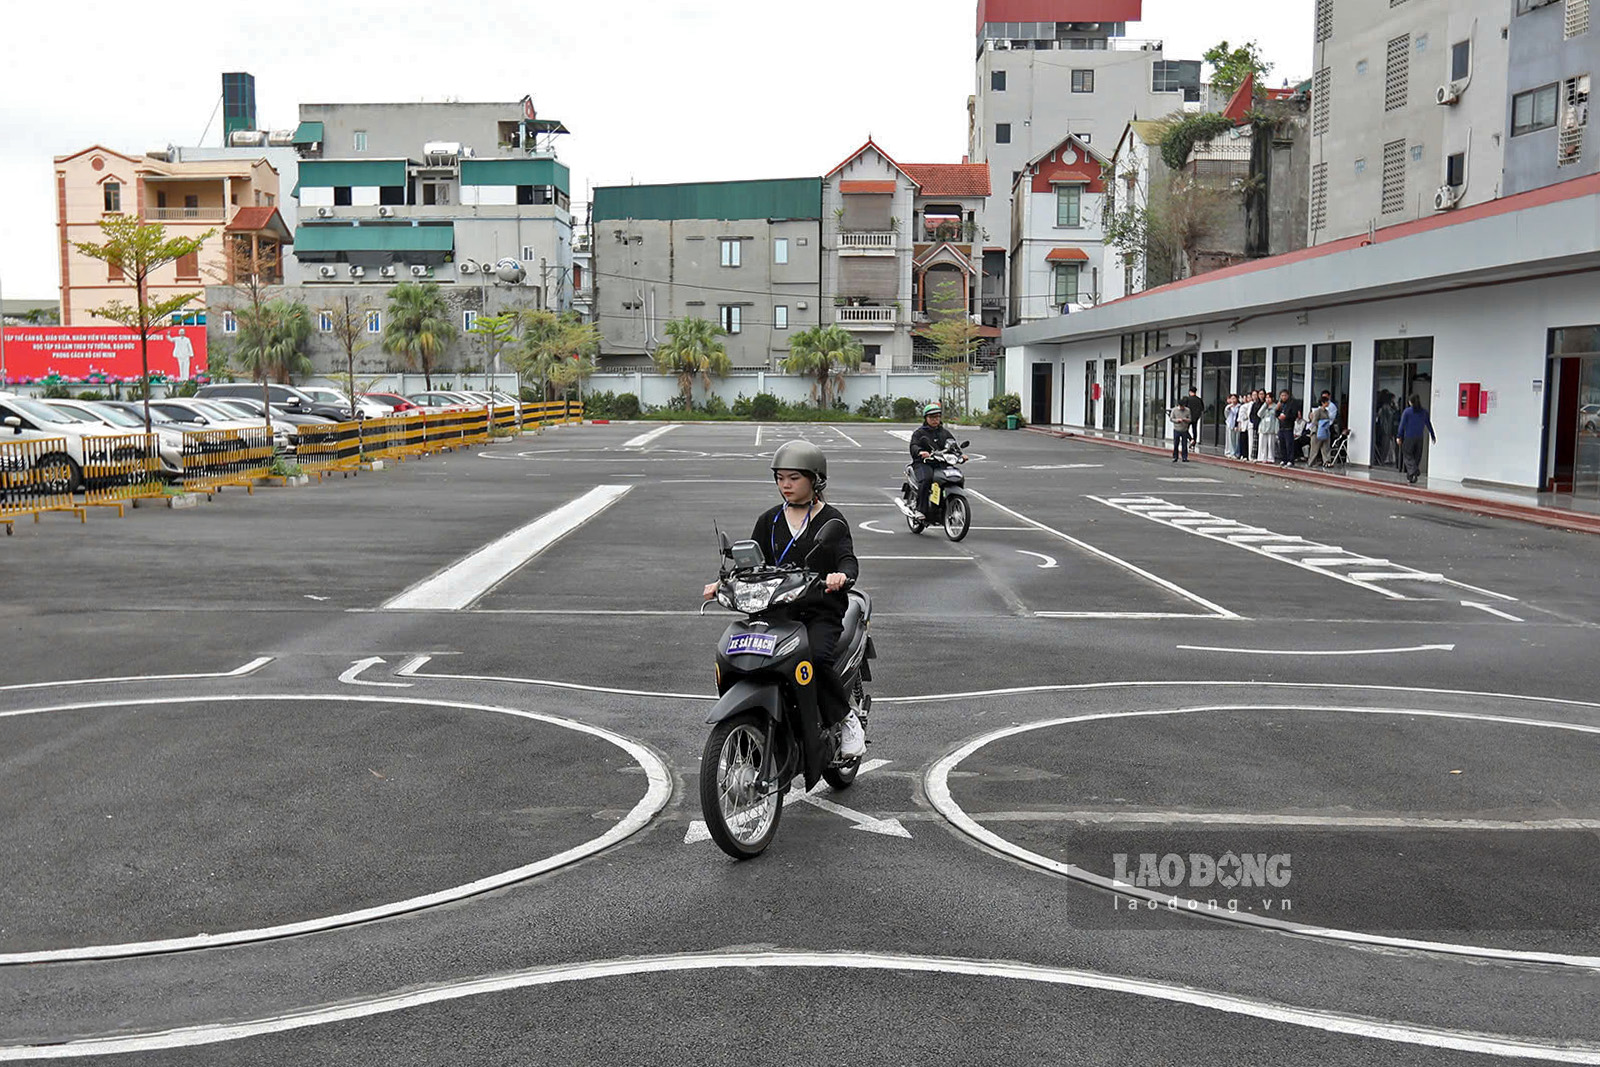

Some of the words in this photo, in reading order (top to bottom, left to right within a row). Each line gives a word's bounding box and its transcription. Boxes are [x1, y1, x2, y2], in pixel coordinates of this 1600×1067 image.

[729, 639, 739, 650] XE
[739, 636, 752, 649] SÁT
[752, 637, 773, 651] HẠCH
[800, 665, 809, 681] 8
